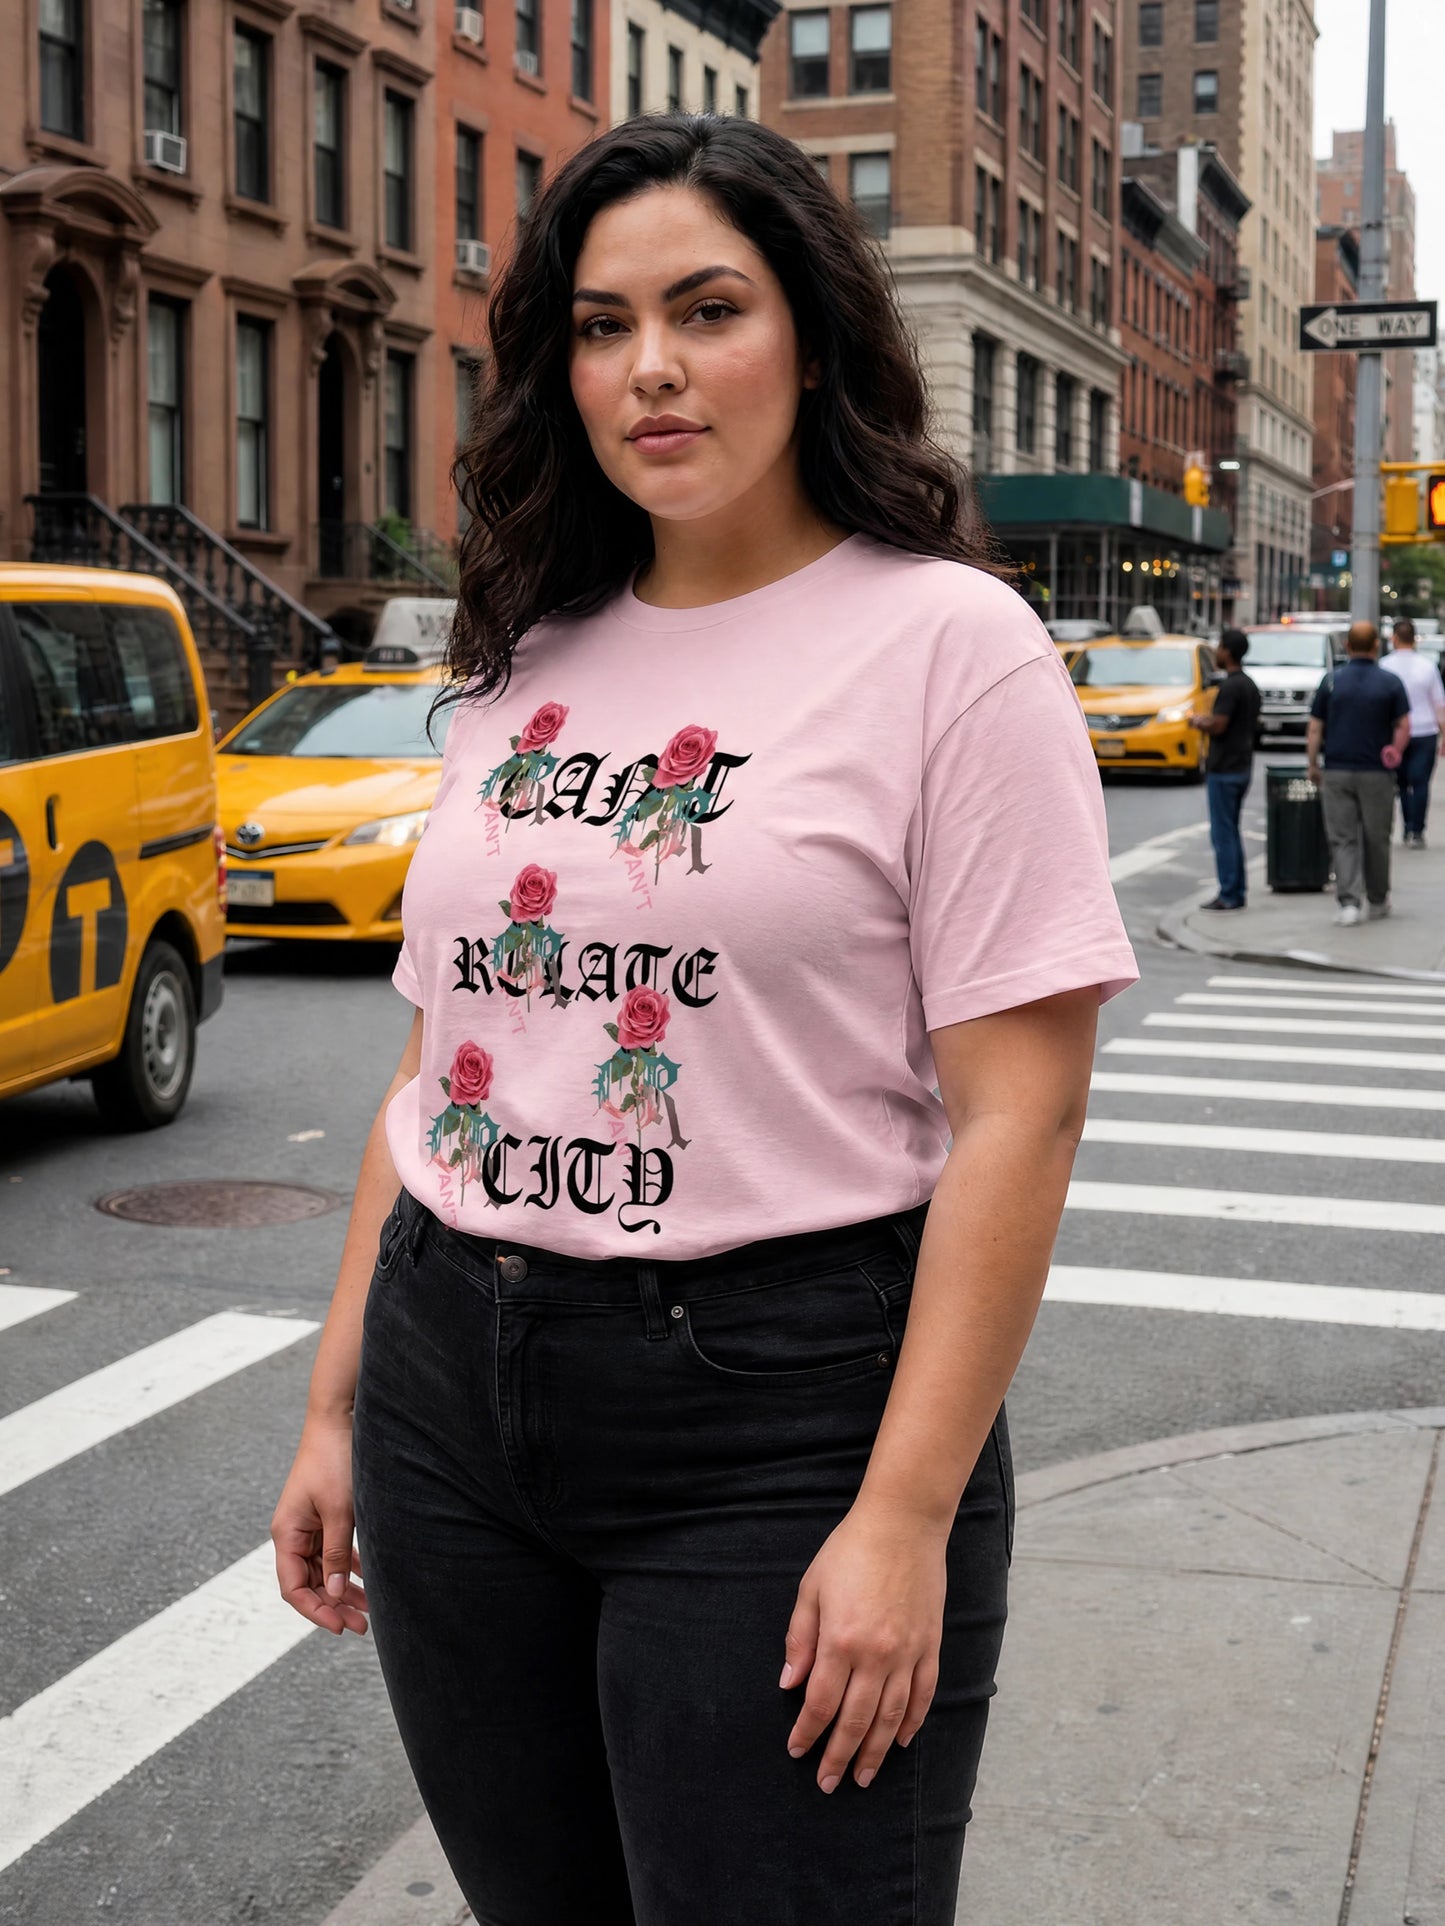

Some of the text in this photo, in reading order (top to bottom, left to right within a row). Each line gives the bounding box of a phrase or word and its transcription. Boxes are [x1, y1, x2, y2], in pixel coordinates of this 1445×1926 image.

[1317, 314, 1423, 337] ONE WAY
[482, 1132, 674, 1235] CITY
